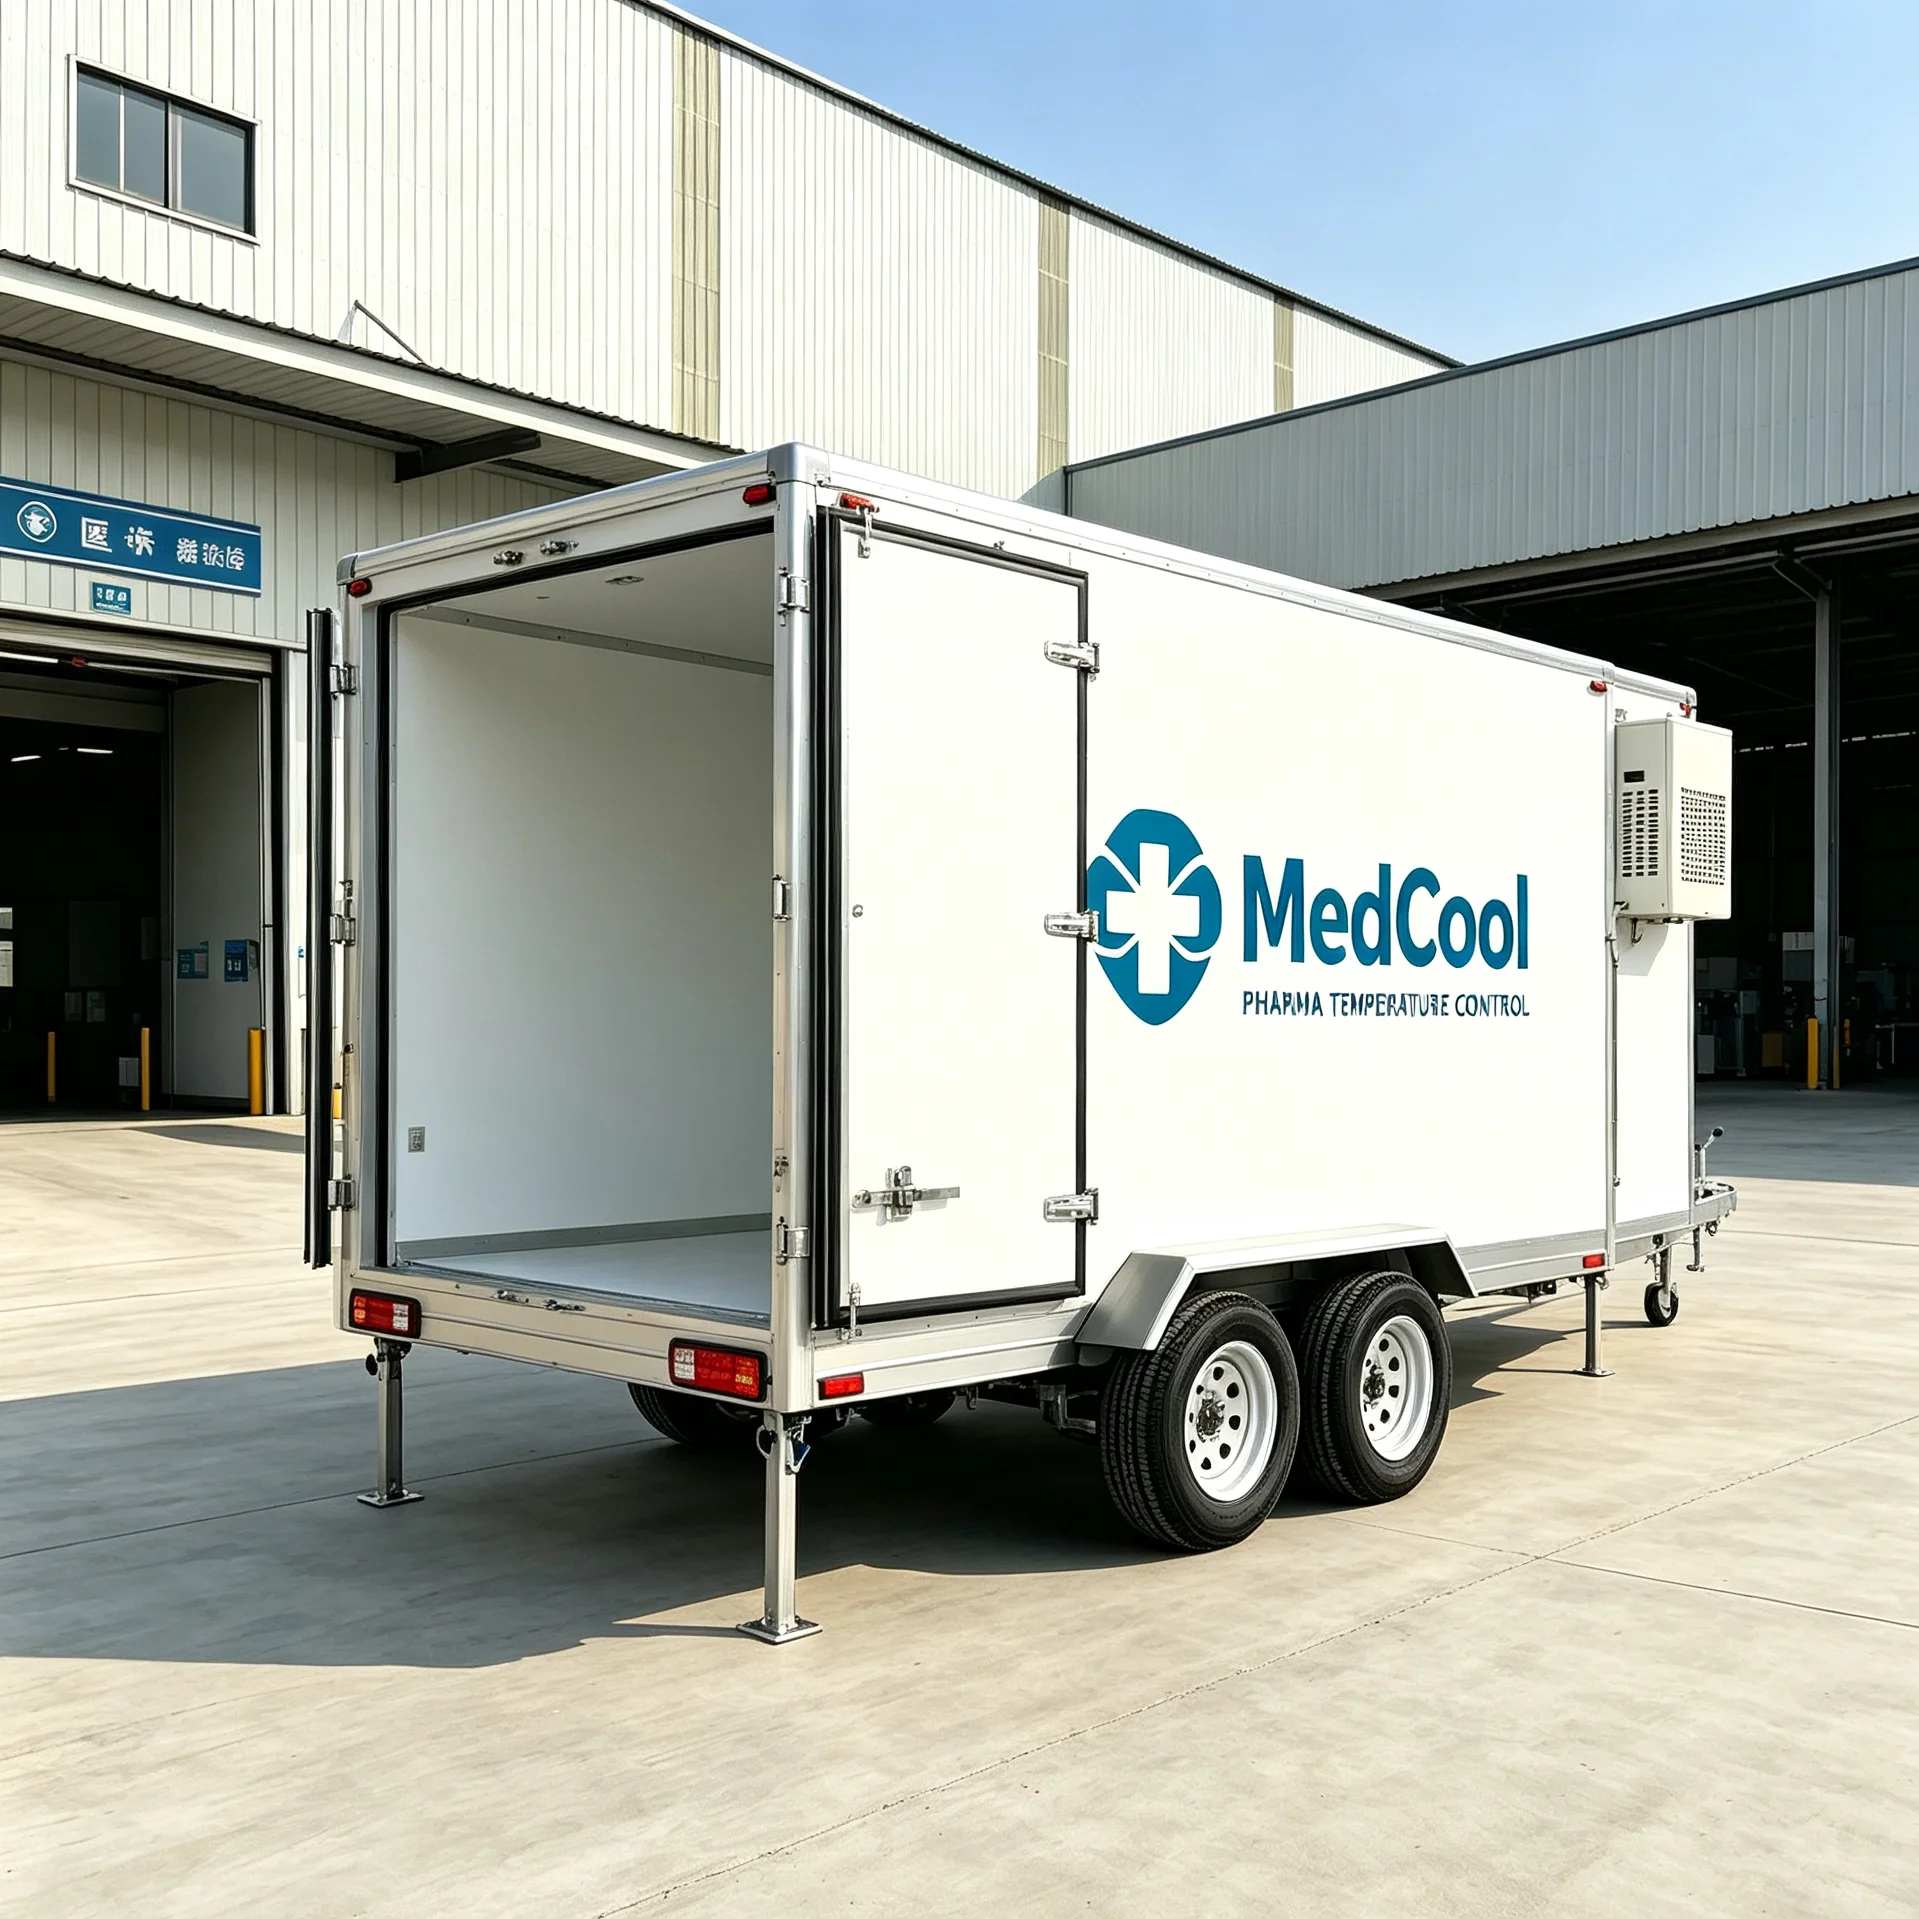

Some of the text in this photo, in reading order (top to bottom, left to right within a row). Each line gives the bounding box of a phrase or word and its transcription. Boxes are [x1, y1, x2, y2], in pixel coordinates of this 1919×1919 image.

[1243, 855, 1528, 970] MedCool
[1243, 991, 1324, 1017] PHARMA
[1454, 993, 1530, 1018] CONTROL
